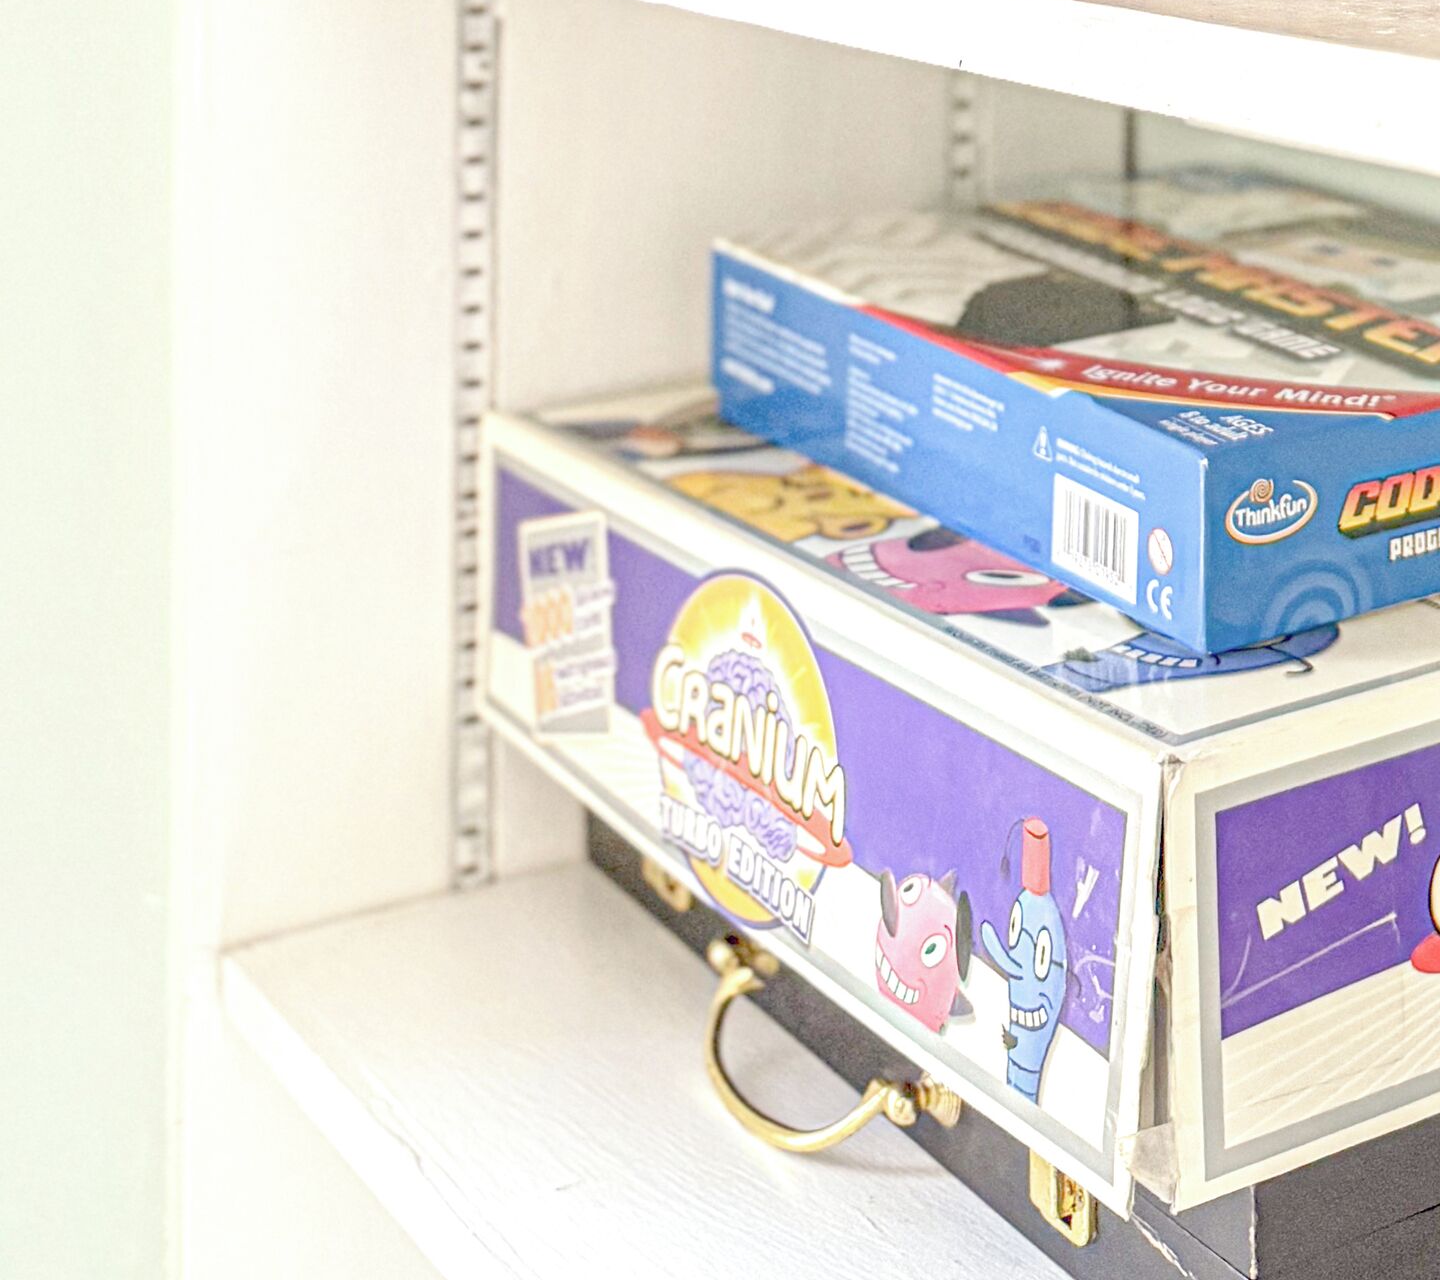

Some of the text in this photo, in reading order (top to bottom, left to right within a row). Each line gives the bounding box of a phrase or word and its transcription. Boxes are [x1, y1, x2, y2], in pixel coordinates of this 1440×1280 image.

[1081, 364, 1178, 387] Ignite
[1188, 376, 1267, 398] Your
[727, 832, 815, 940] EDITION
[1255, 802, 1429, 941] NEW!
